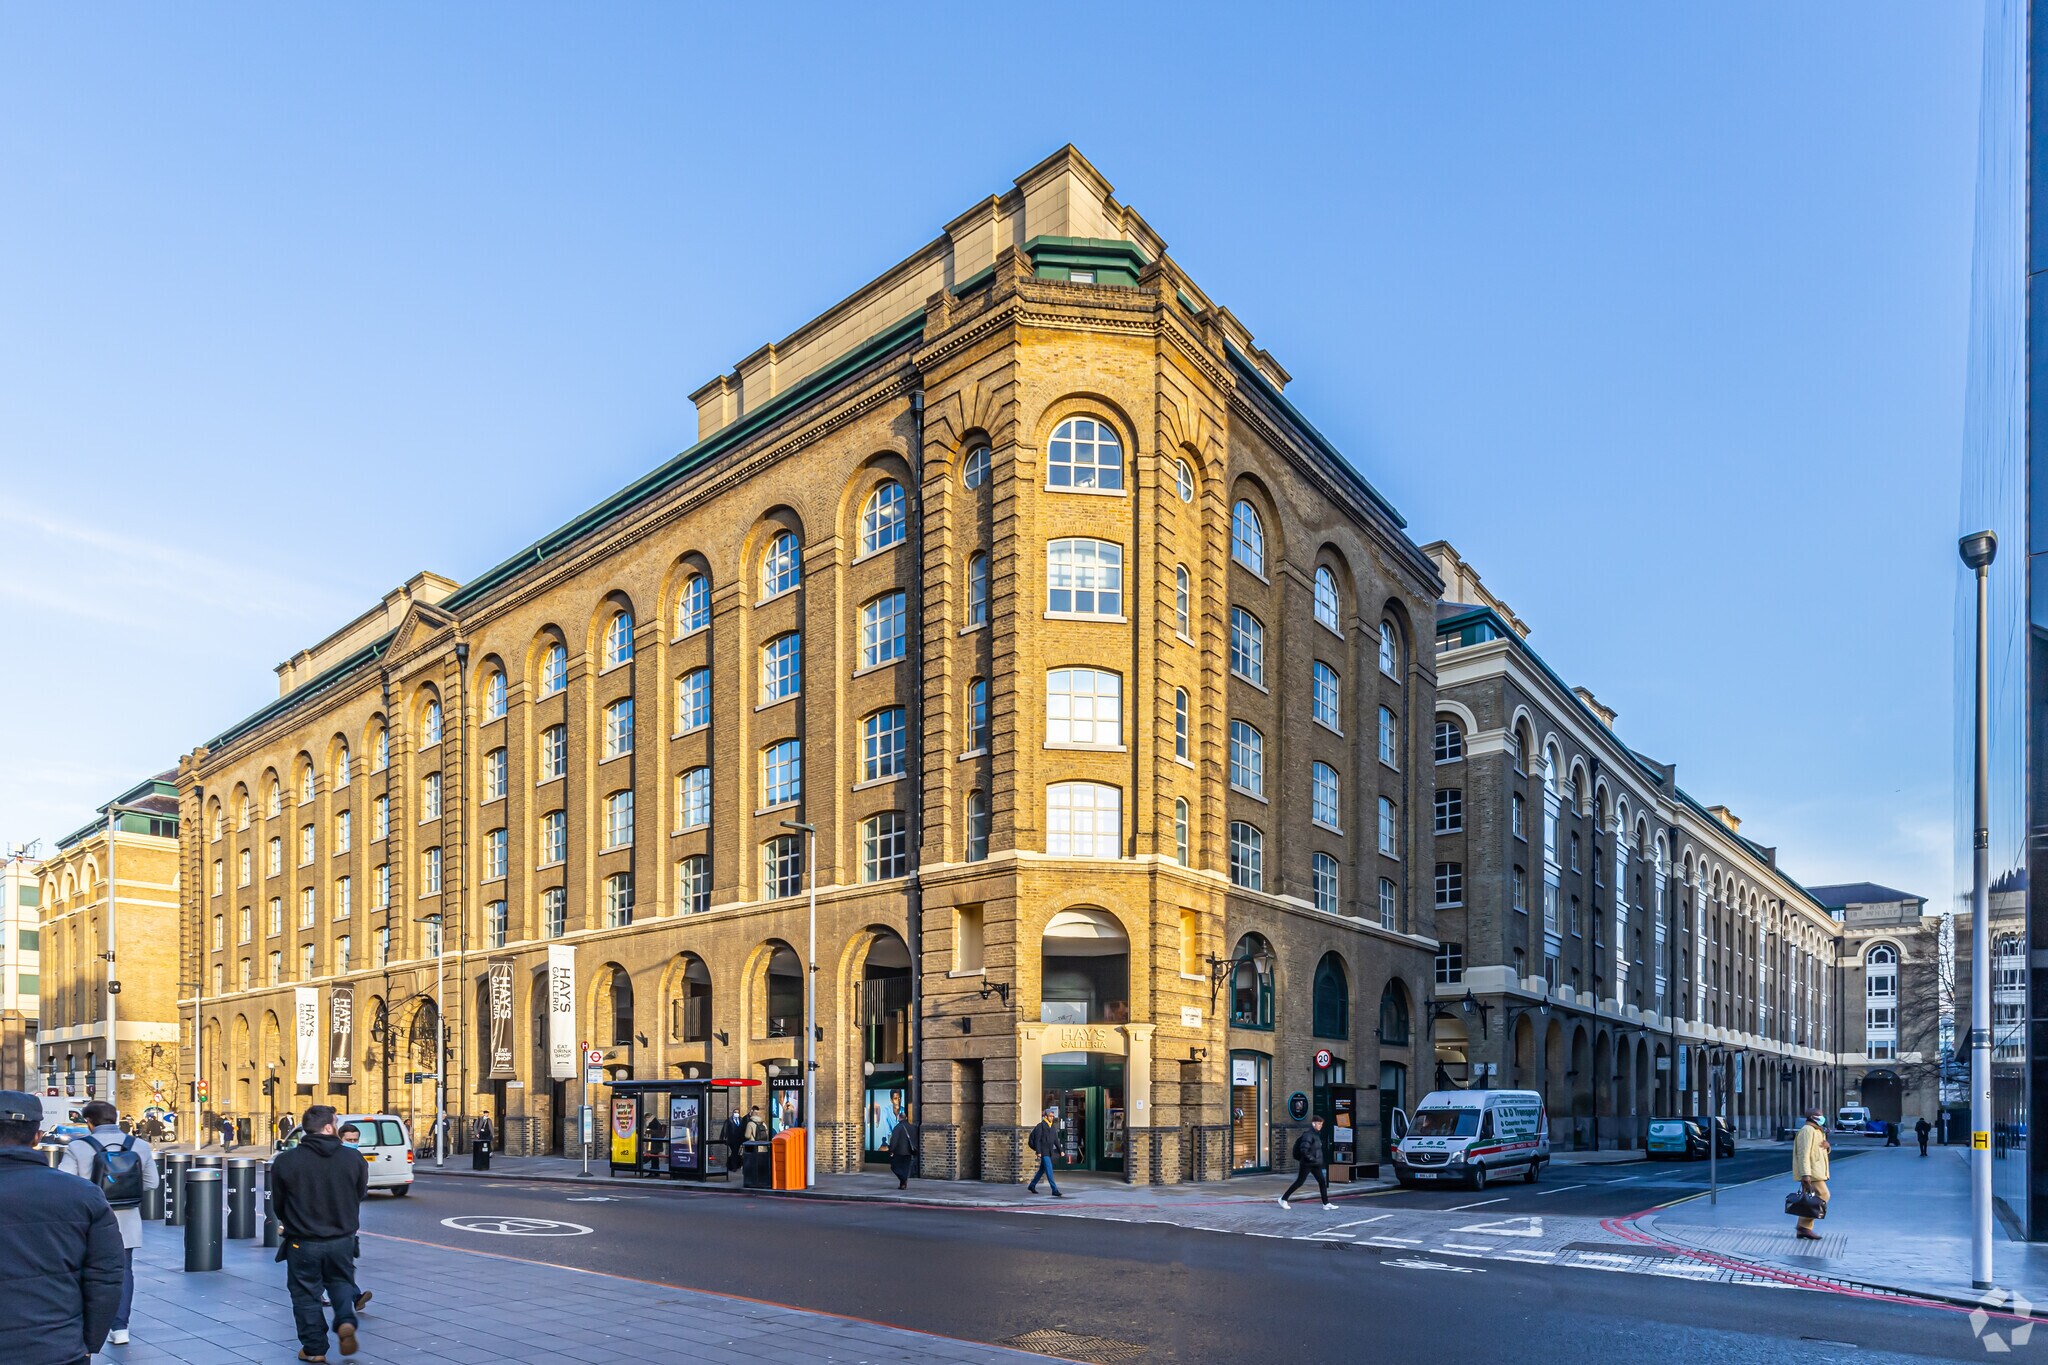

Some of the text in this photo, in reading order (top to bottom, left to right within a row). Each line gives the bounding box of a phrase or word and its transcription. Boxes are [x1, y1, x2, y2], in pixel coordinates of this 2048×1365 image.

[492, 976, 500, 1019] GALLERIA
[499, 976, 512, 1019] HAY'S
[560, 967, 571, 1013] HAY'S
[306, 1004, 315, 1037] HAY'S
[340, 998, 351, 1034] HAY'S
[1062, 1028, 1106, 1041] HAY'S
[1318, 1054, 1329, 1063] 20
[1974, 1133, 1988, 1148] H
